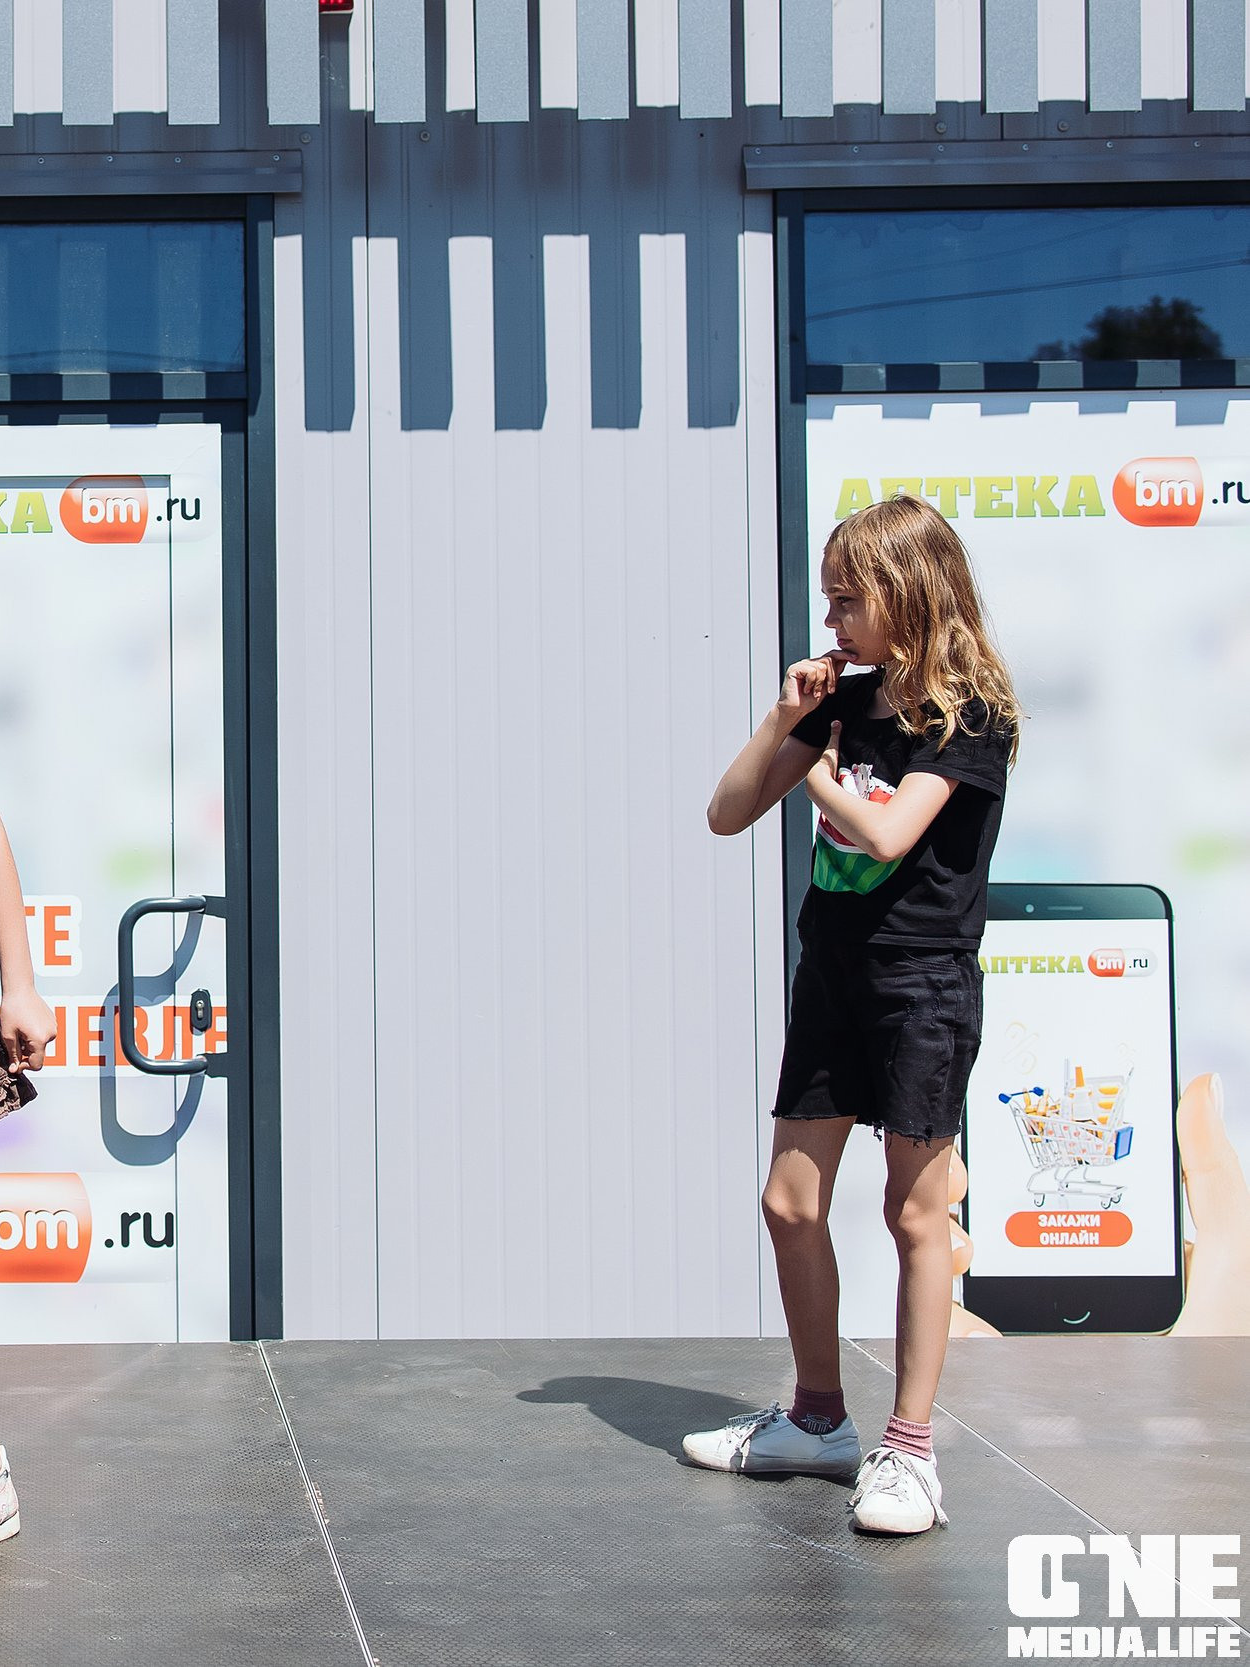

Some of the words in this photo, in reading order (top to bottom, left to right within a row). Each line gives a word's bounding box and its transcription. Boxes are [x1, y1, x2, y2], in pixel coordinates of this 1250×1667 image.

[1135, 471, 1196, 507] bm
[82, 488, 141, 524] bm
[1038, 1214, 1101, 1228] ЗАКАЖИ
[1039, 1230, 1100, 1246] ОНЛАЙН
